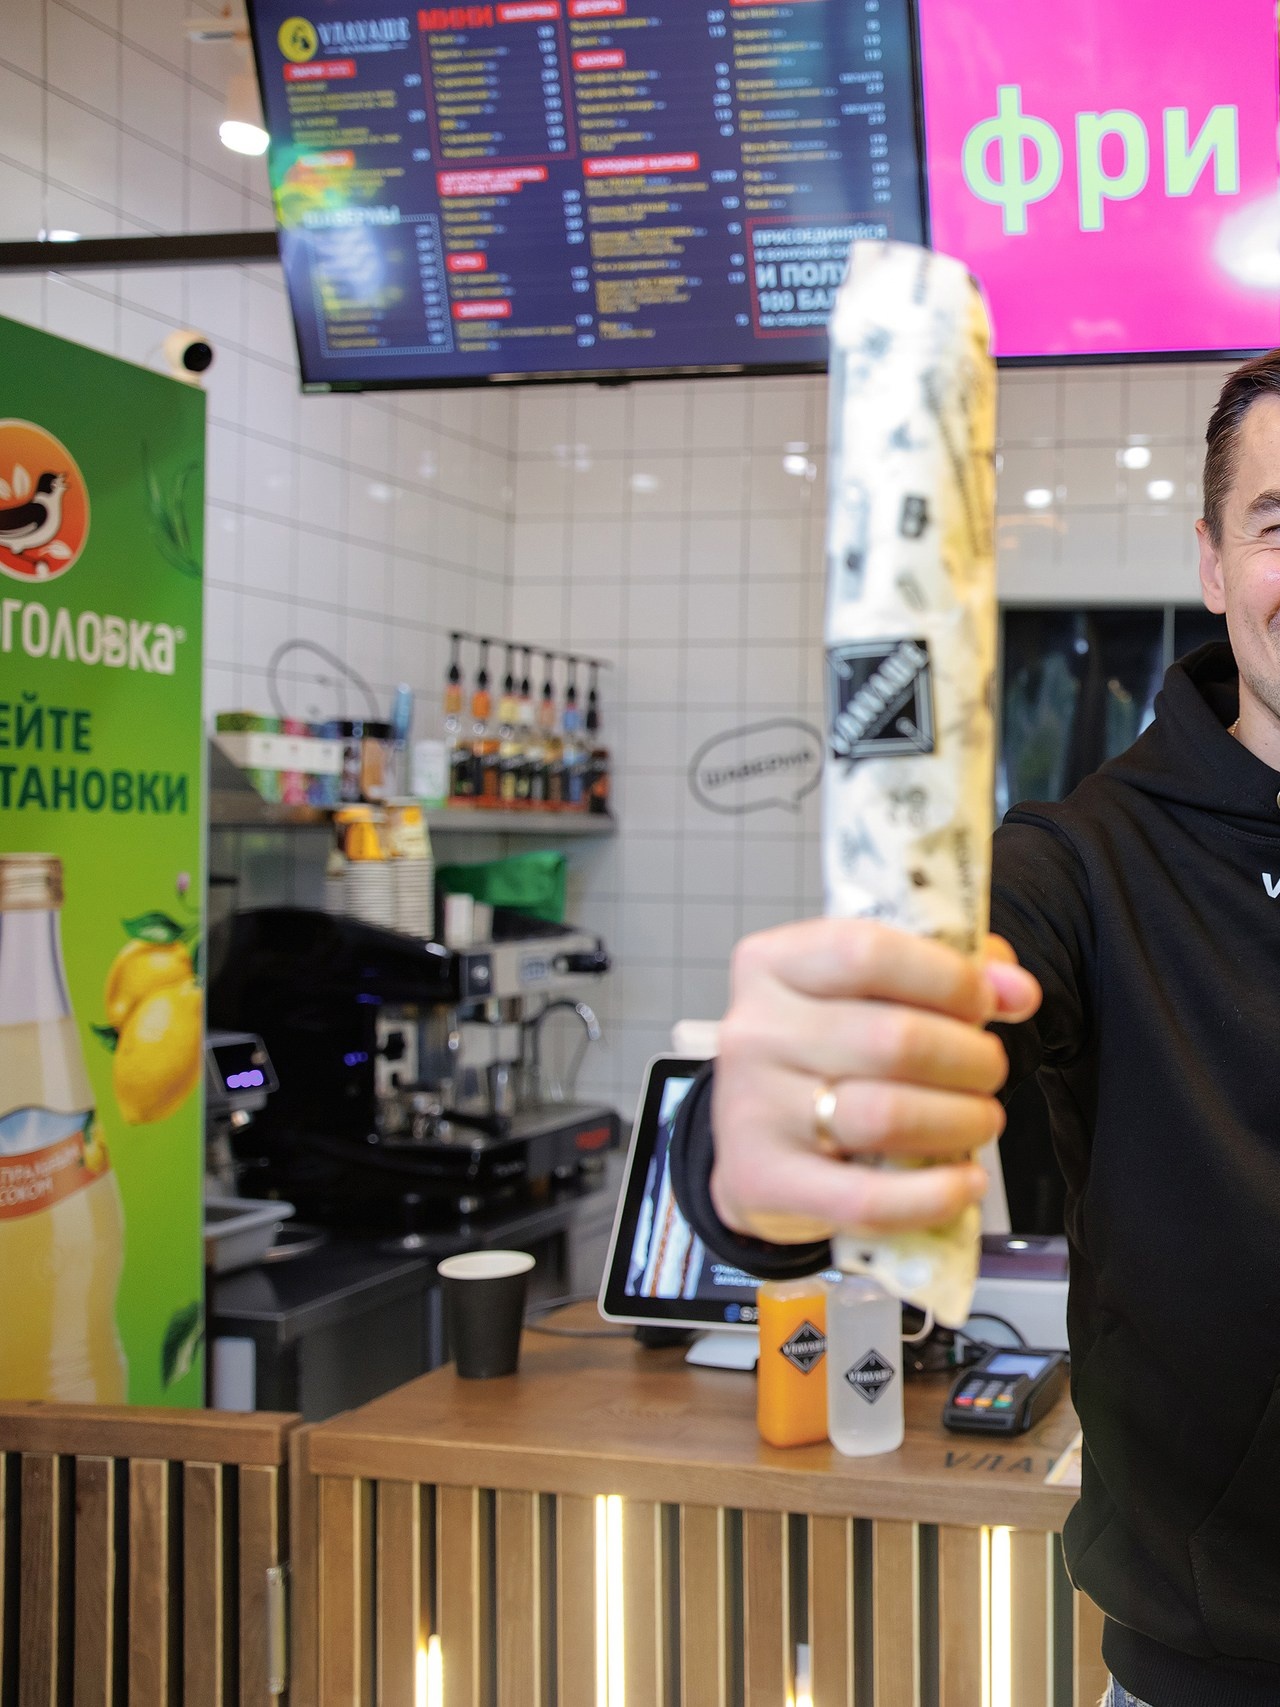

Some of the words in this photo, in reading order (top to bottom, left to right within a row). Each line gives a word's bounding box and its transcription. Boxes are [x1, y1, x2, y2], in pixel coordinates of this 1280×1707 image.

[961, 84, 1241, 236] фри
[755, 263, 778, 289] И
[944, 1449, 1057, 1474] VЛА
